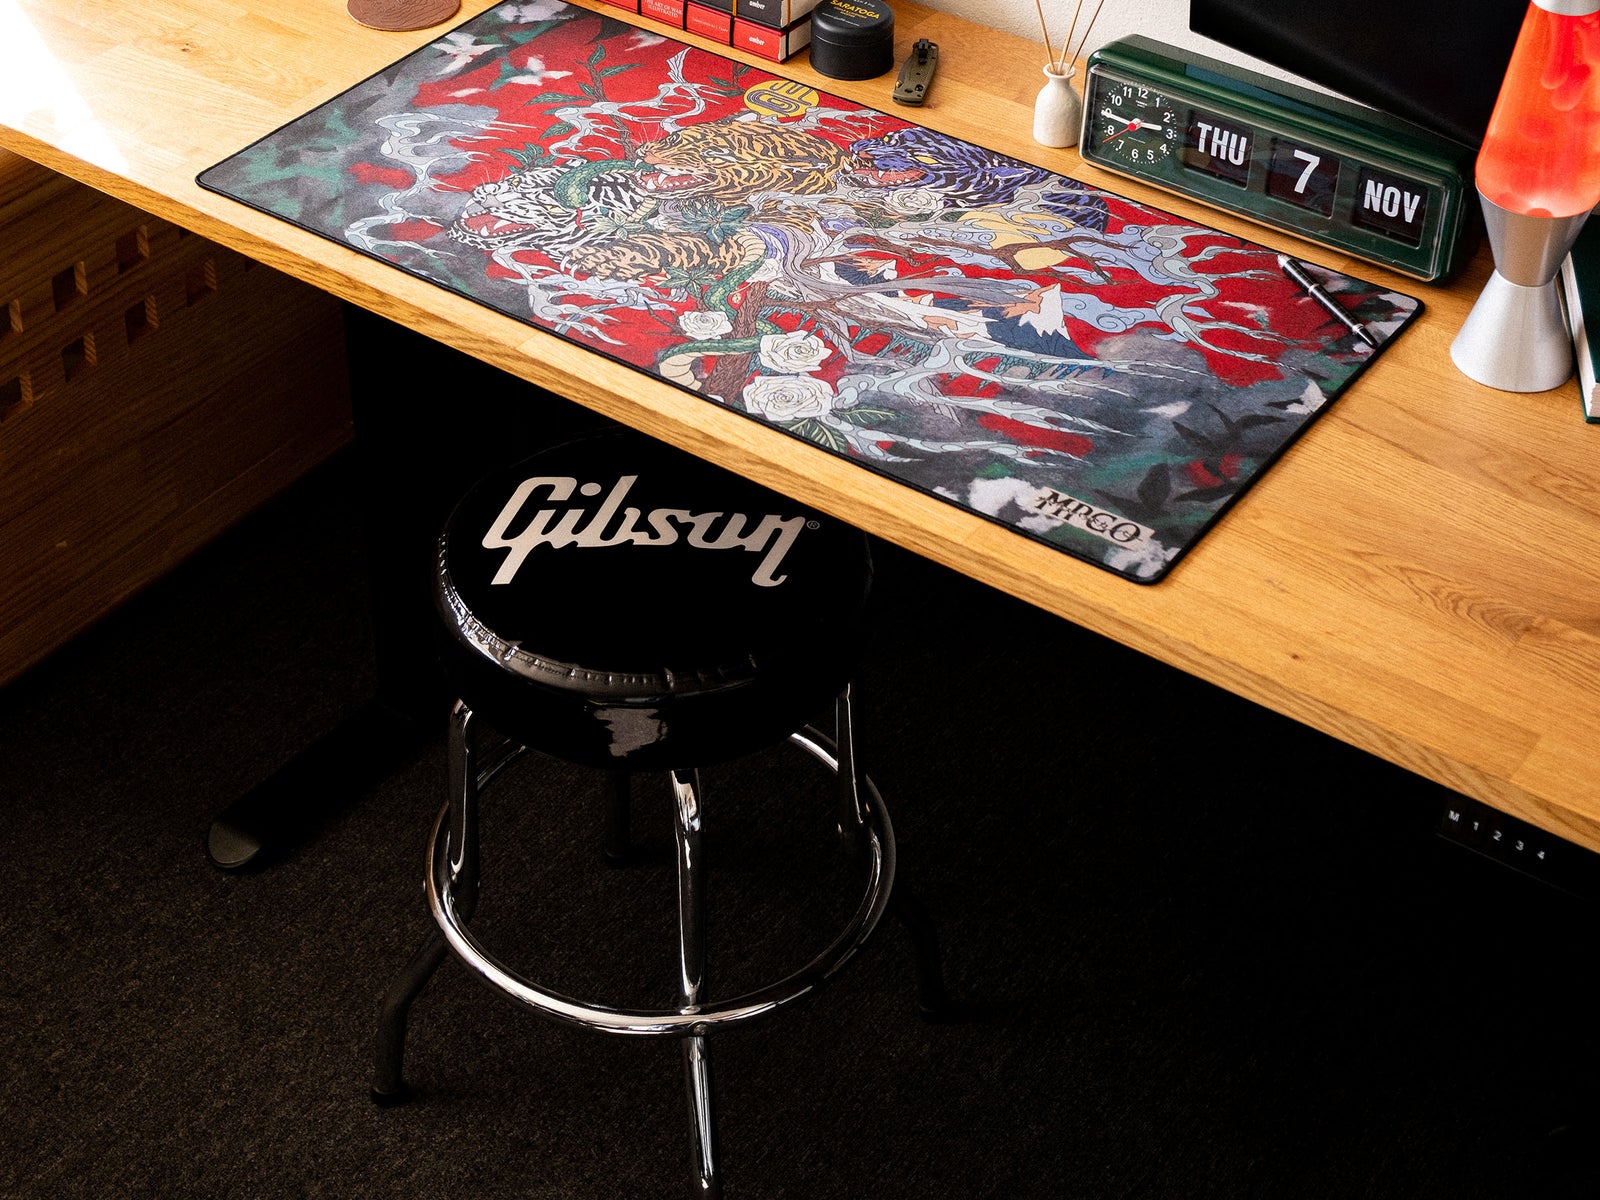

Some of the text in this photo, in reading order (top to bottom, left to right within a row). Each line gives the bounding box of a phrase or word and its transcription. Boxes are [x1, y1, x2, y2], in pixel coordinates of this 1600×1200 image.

[647, 3, 679, 18] ILLUSTRATED
[654, 0, 664, 8] ART
[663, 3, 671, 11] OF
[671, 6, 683, 15] WAR
[749, 0, 766, 10] amber
[830, 0, 880, 19] SARATOGA
[748, 36, 766, 46] amber
[1123, 86, 1133, 99] 11
[1138, 87, 1149, 99] 12
[1111, 94, 1122, 107] 10
[1155, 97, 1160, 108] 1
[1163, 112, 1171, 123] 2
[1107, 125, 1115, 135] 8
[1165, 128, 1173, 139] 3
[1118, 139, 1124, 149] 7
[1159, 143, 1167, 153] 4
[1131, 148, 1139, 159] 6
[1146, 149, 1154, 160] 5
[1197, 121, 1421, 224] THU 7 NOV
[481, 475, 806, 587] Gibson
[1448, 809, 1545, 860] M 1 2 3 4
